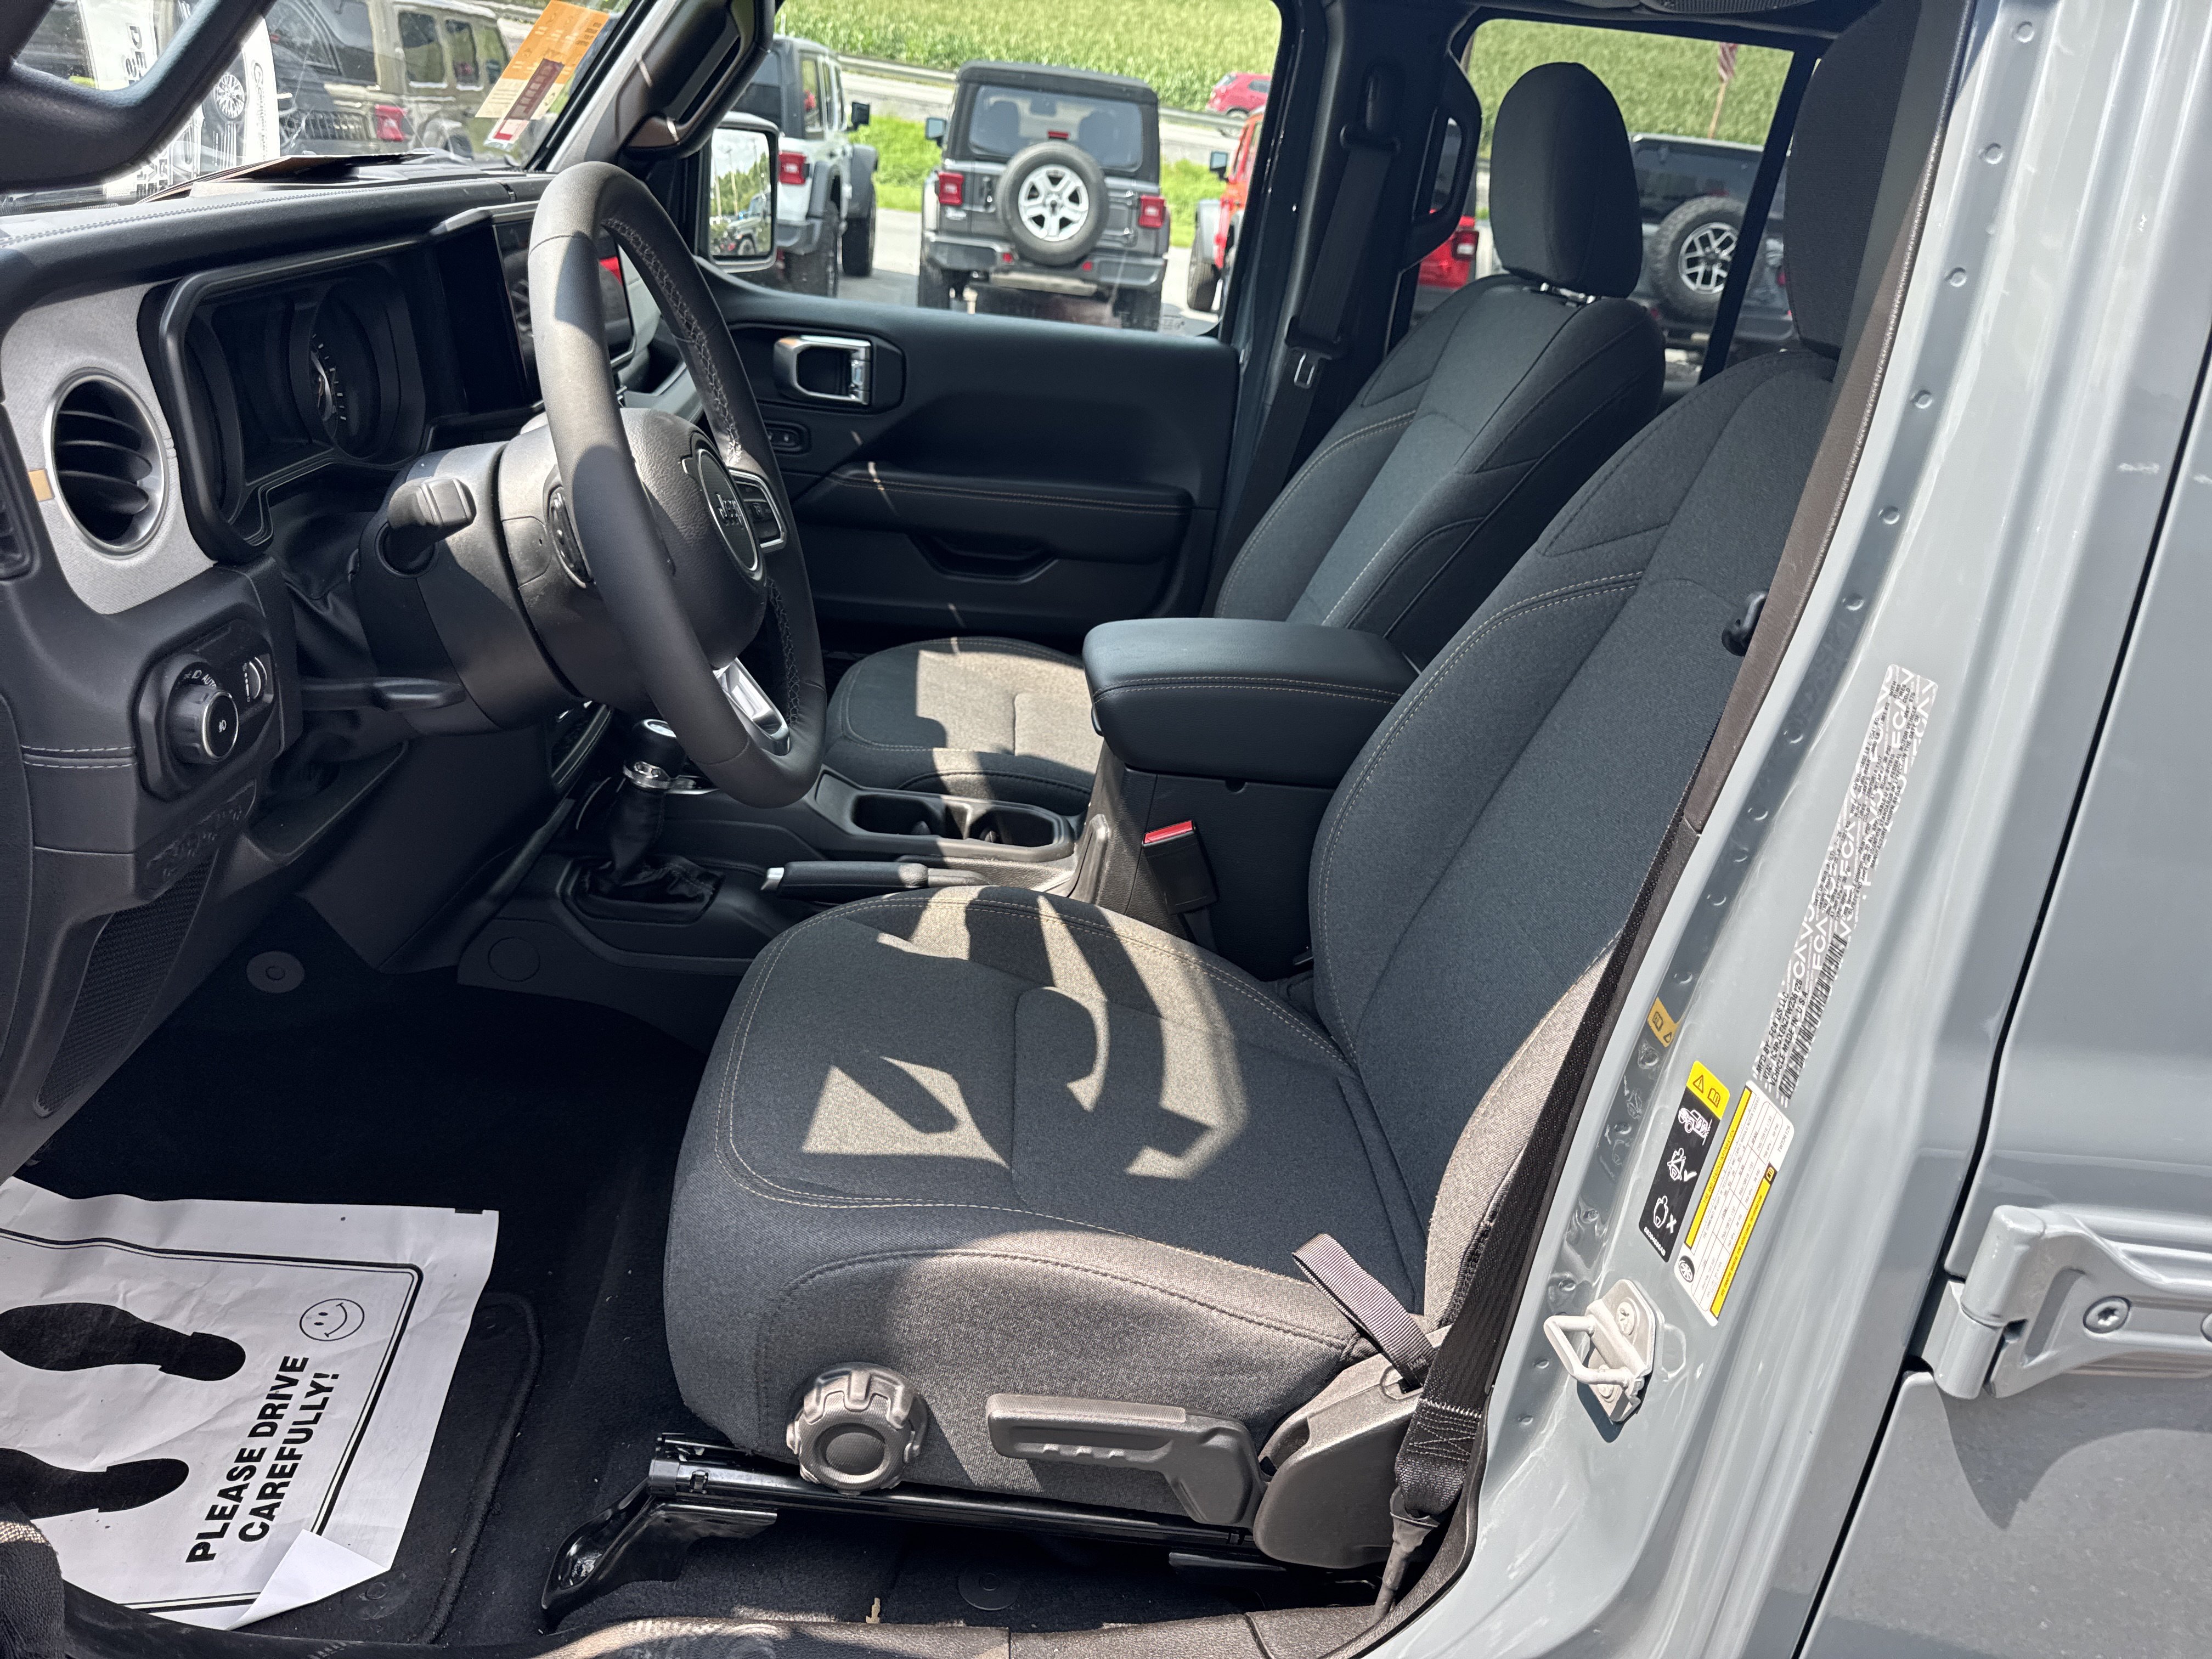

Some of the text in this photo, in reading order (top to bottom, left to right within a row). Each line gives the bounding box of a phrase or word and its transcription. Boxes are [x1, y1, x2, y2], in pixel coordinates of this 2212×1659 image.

[1898, 730, 1909, 751] MOTOR
[1905, 706, 1917, 729] VEHICLE
[1878, 793, 1893, 826] STANDARDS
[1908, 724, 1916, 739] DATE
[1756, 990, 1789, 1074] MFD BY: FCA US LLC
[1763, 977, 1803, 1081] VIN: 1C4PJXEN2TW236126
[1770, 1052, 1785, 1087] VEHICLE
[1781, 1028, 1794, 1053] MADE
[1711, 1160, 1722, 1183] LOADING
[1719, 1128, 1734, 1162] INFORMATION
[1777, 1124, 1790, 1153] TW236126
[185, 1356, 309, 1562] PLEASE DRIVE
[238, 1373, 339, 1542] CAREFULLY!
